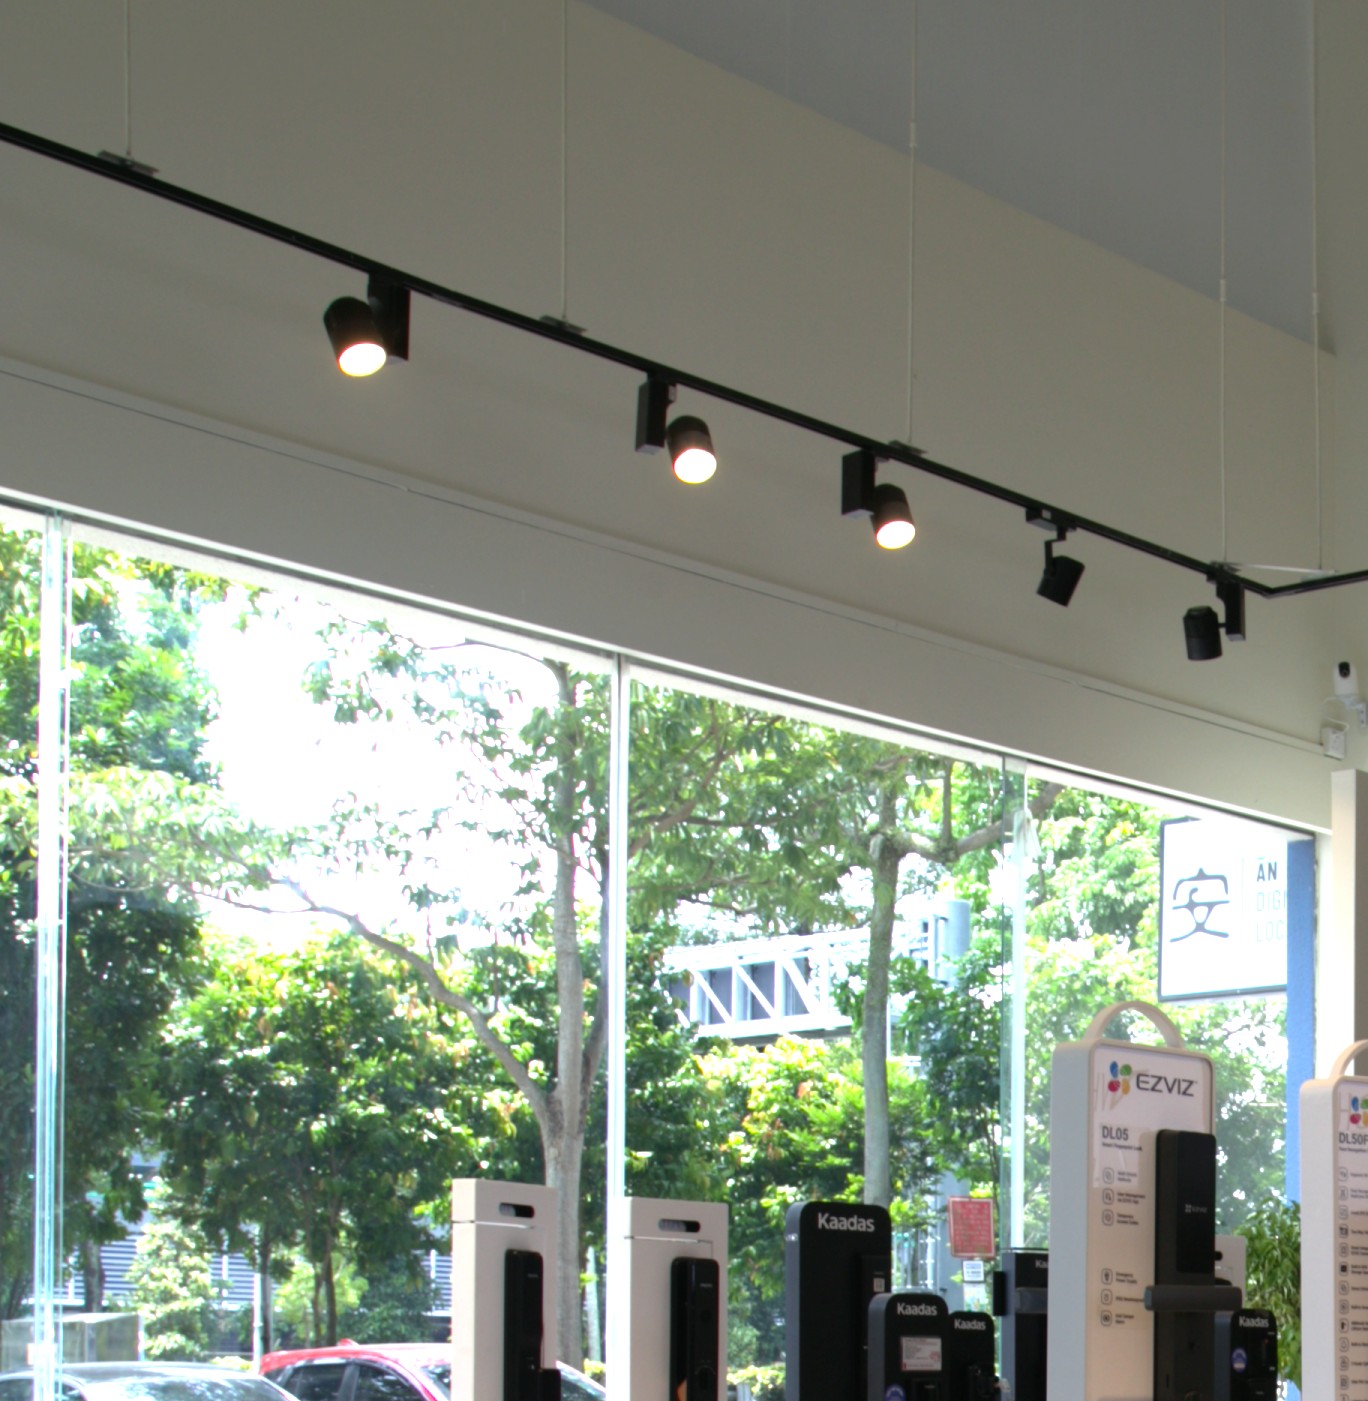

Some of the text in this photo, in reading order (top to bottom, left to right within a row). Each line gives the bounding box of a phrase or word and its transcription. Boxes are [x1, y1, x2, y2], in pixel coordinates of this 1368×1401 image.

[1169, 867, 1230, 943] 安
[1256, 889, 1287, 912] DIGI
[1256, 919, 1286, 942] LOC
[1135, 1075, 1196, 1098] EZVIZ
[1101, 1125, 1129, 1141] DL05
[817, 1212, 876, 1233] Kaadas
[896, 1302, 938, 1317] Kaadas
[954, 1318, 986, 1331] Kaadas
[1238, 1314, 1270, 1329] Kaadas
